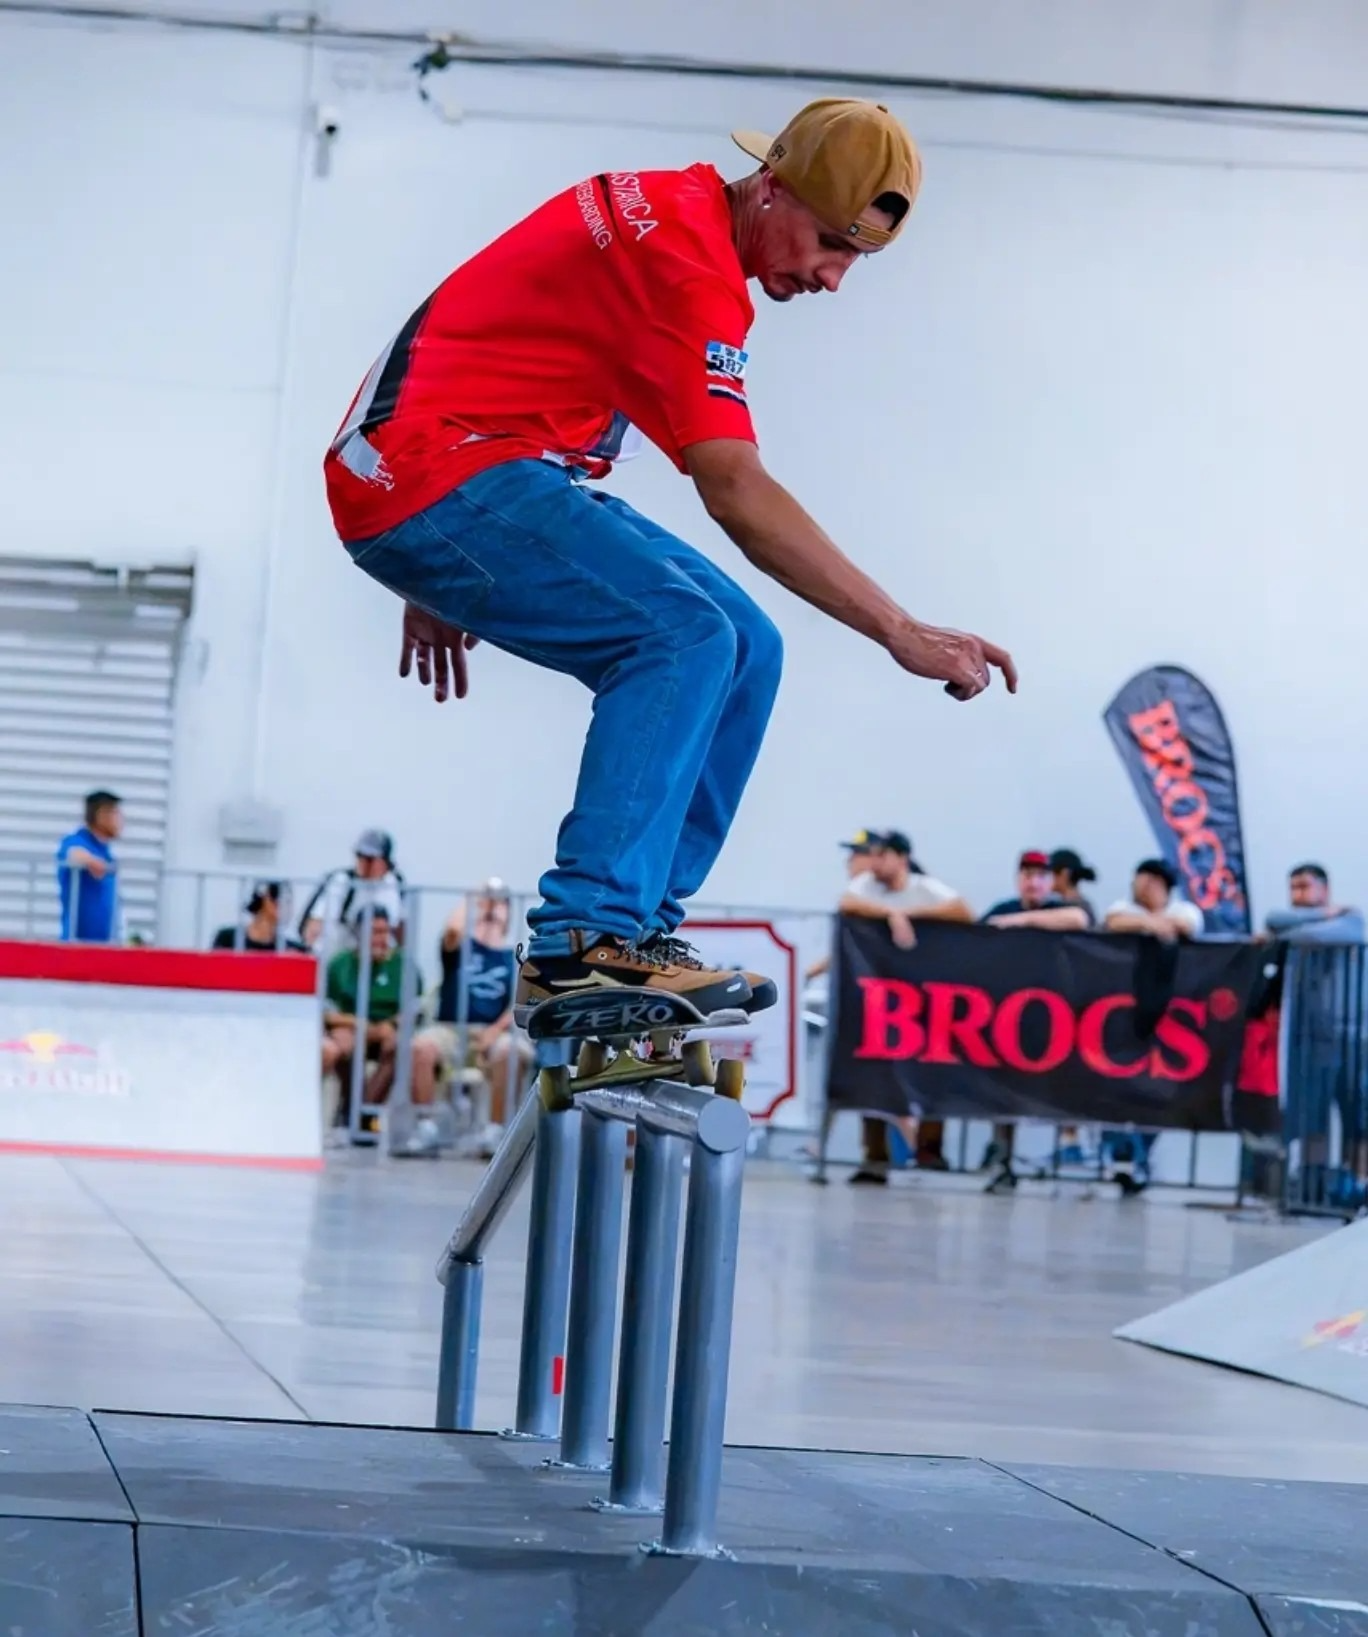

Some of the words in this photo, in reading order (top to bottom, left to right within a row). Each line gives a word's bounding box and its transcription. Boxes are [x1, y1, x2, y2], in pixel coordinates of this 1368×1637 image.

[1127, 699, 1234, 910] BROCS
[552, 1002, 674, 1033] ZERO
[853, 976, 1211, 1082] BROCS
